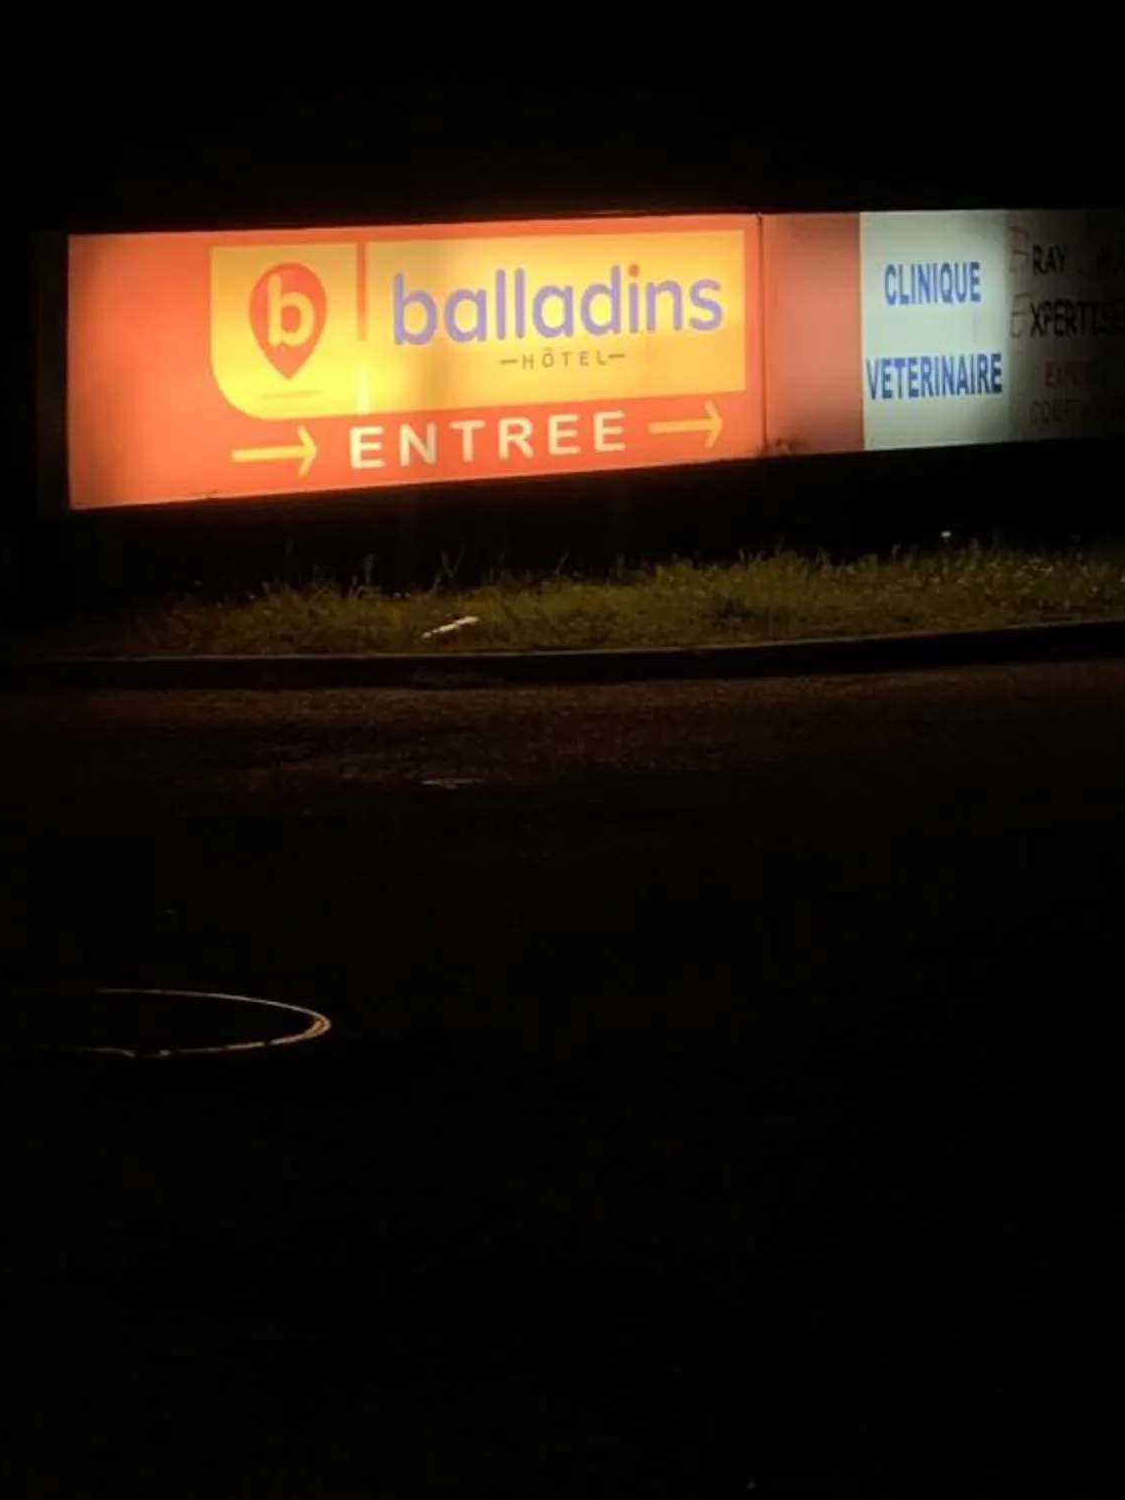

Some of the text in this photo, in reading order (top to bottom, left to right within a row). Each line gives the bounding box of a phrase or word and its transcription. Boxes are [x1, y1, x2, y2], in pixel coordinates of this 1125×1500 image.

[268, 274, 315, 347] b
[392, 264, 724, 347] balladins
[884, 262, 982, 306] CLINIQUE
[522, 347, 607, 369] HÔTEL
[866, 353, 1003, 400] VETERINAIRE
[349, 411, 627, 470] ENTREE
